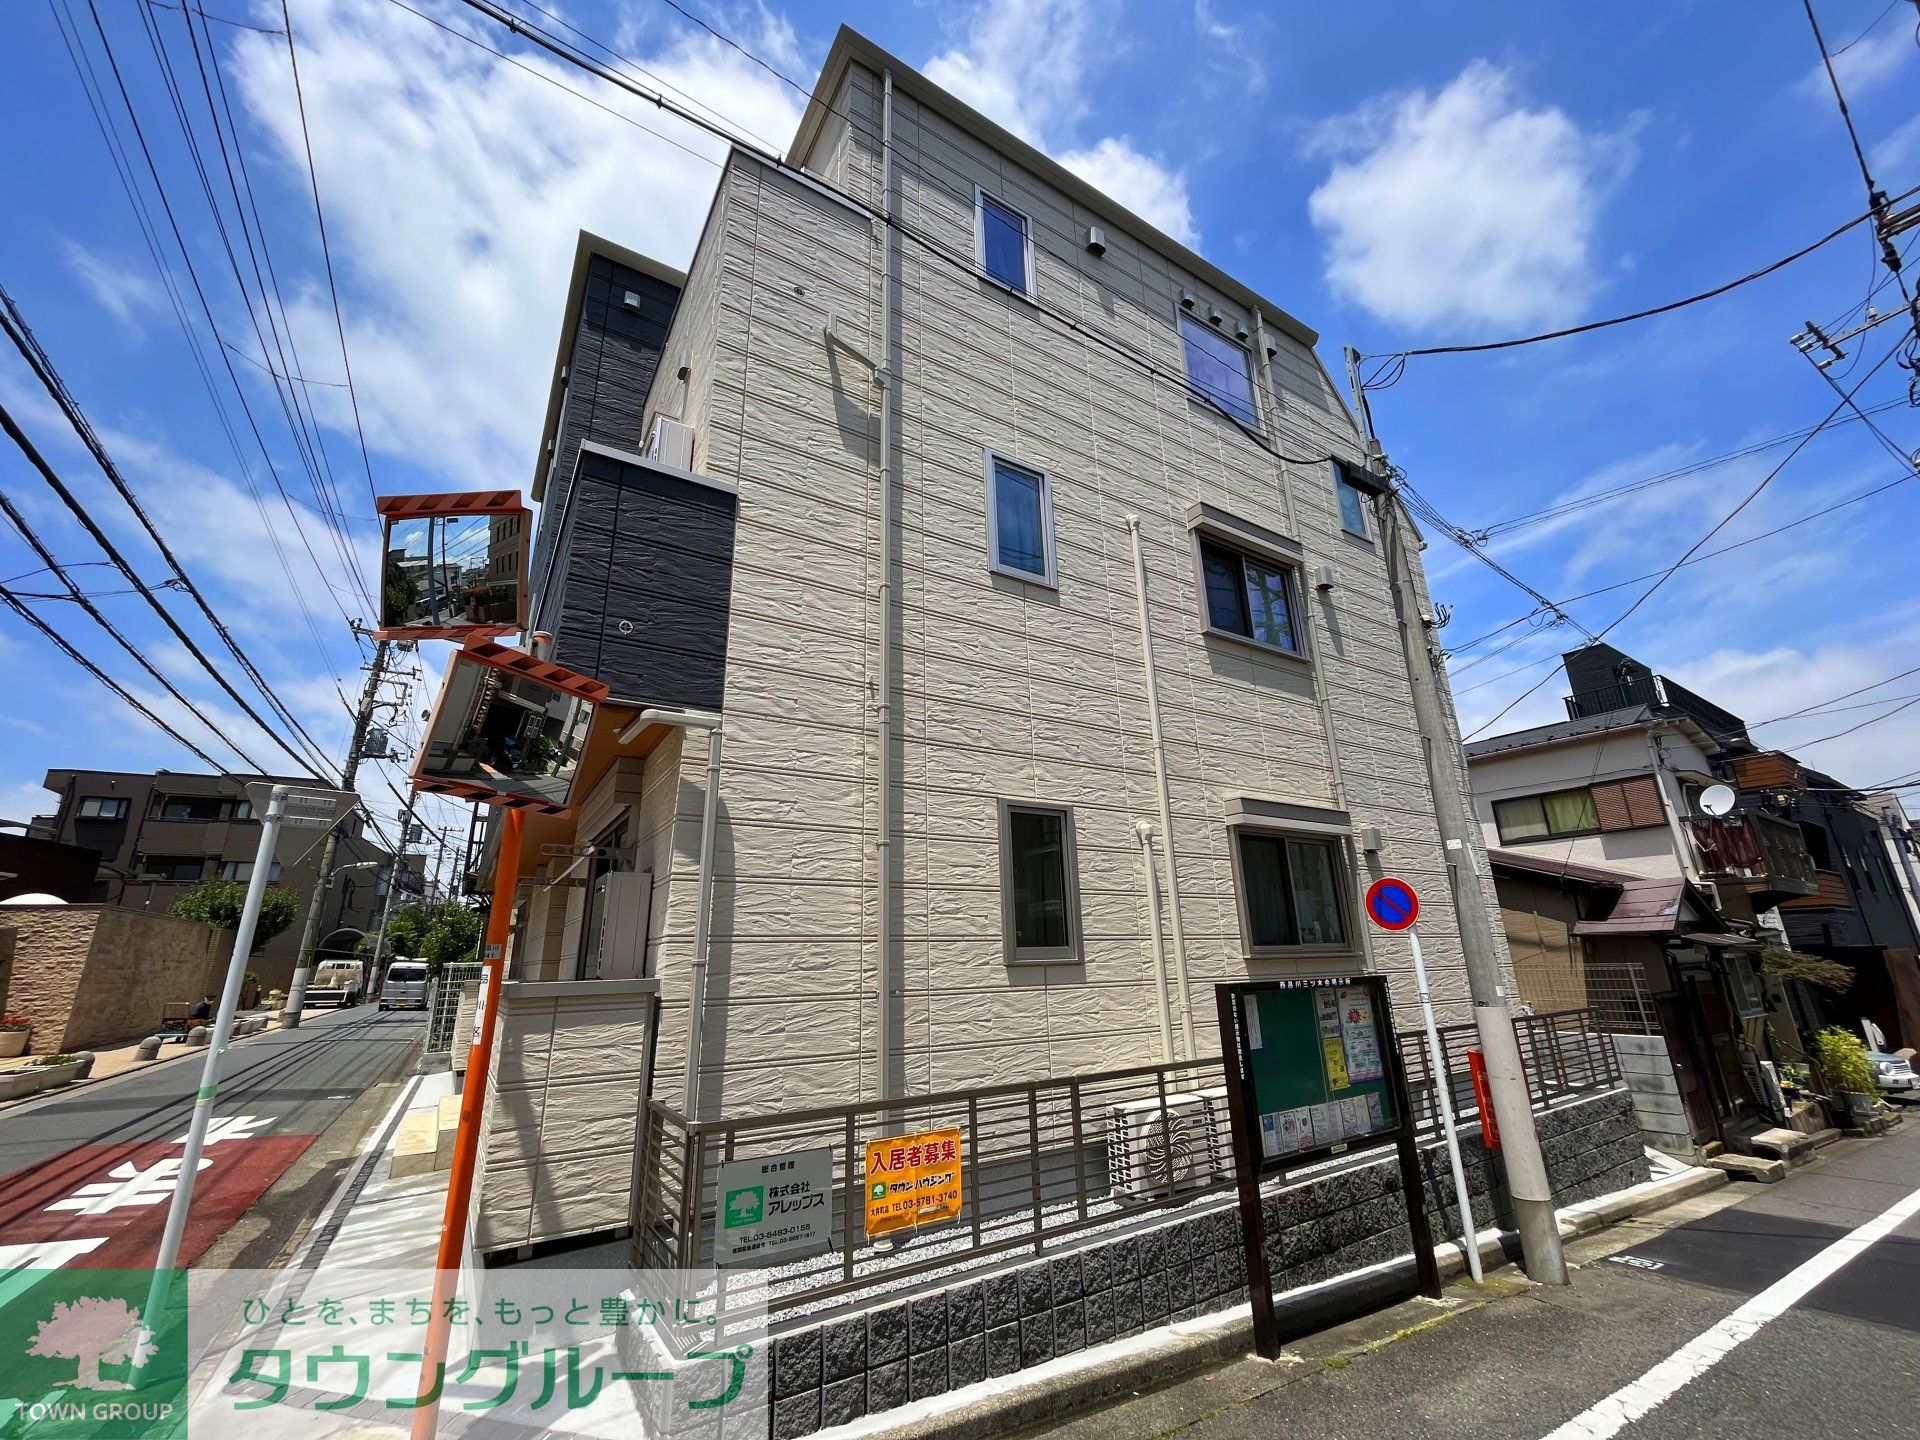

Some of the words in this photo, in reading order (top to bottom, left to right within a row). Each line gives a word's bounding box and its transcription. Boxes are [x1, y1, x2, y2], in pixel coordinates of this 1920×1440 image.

[761, 1160, 795, 1174] 総合管理
[869, 1139, 956, 1175] 入居者募集
[768, 1180, 811, 1199] 株式会社
[889, 1173, 955, 1192] タウンハウジング
[768, 1193, 825, 1216] アレップス
[739, 1223, 811, 1244] TEL.03-5483-0155
